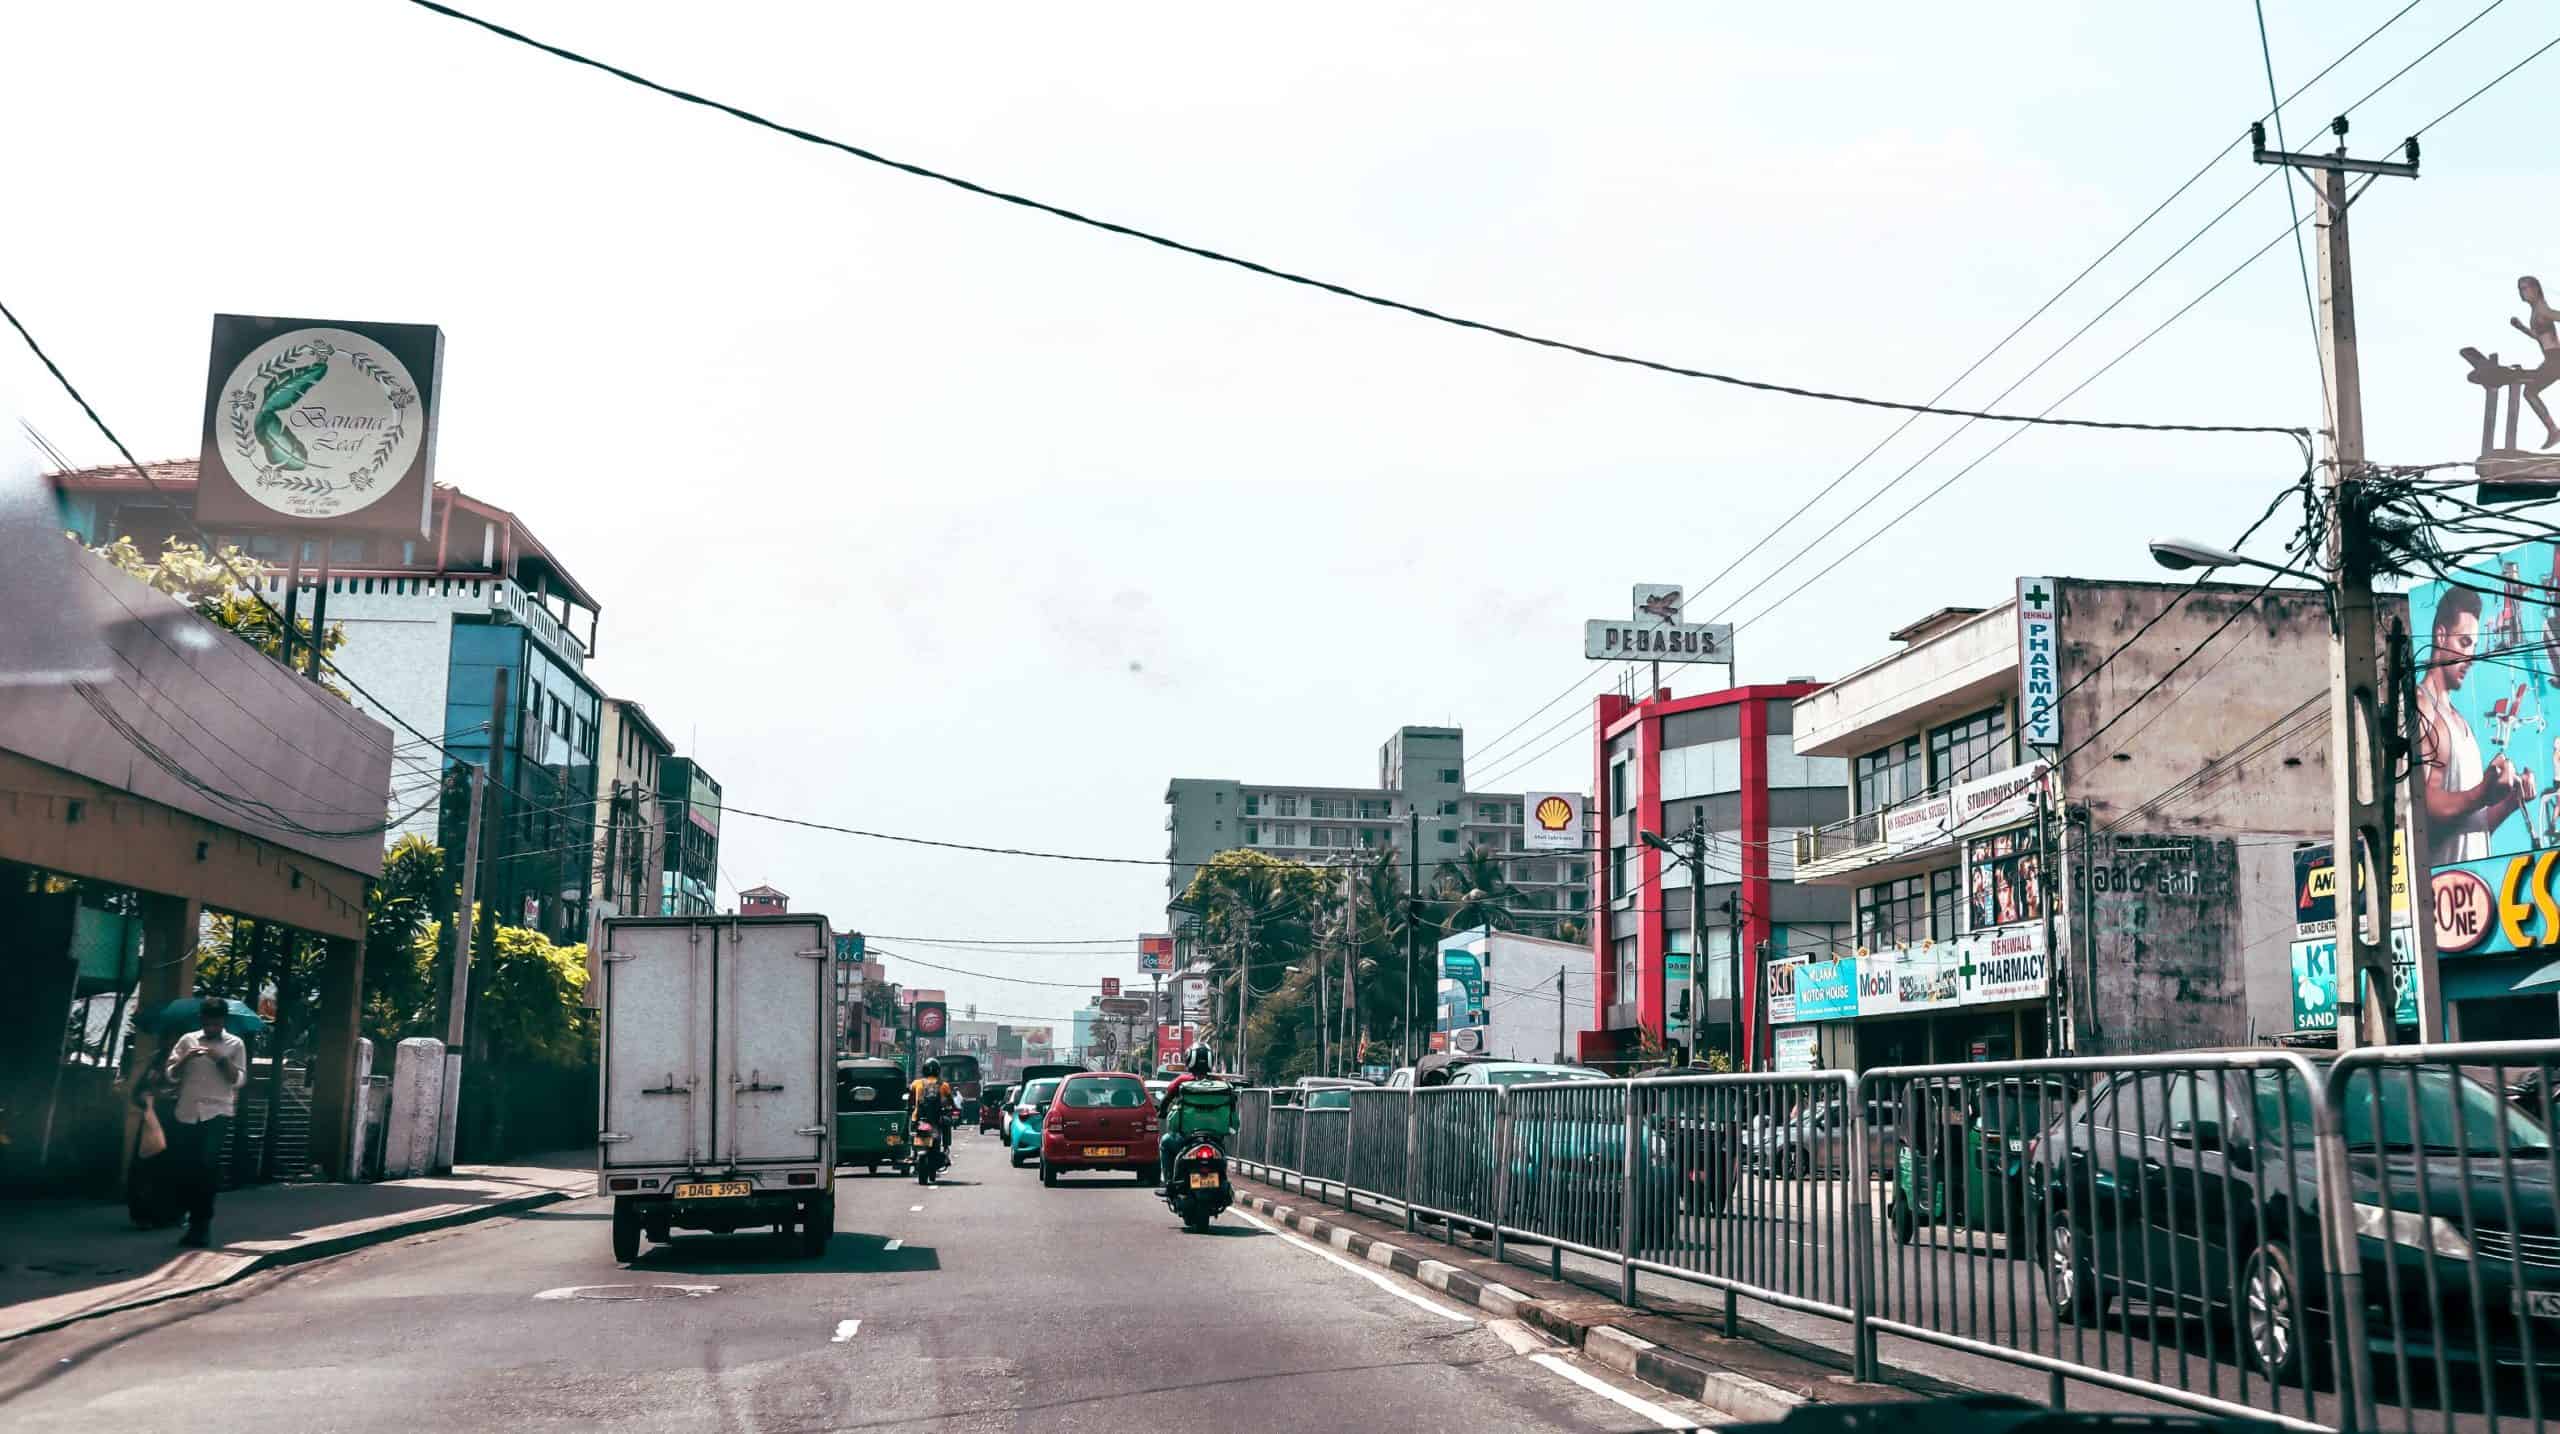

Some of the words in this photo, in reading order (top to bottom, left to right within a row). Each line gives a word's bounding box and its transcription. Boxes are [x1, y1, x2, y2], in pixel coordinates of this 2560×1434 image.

[289, 406, 384, 431] Banana
[312, 431, 369, 451] Leaf
[1606, 628, 1716, 654] PEGASUS
[2029, 624, 2051, 738] PHARMACY
[2316, 921, 2337, 933] CENTR
[1991, 935, 2032, 957] DEHIWALA
[1979, 954, 2045, 986] PHARMACY
[1826, 984, 1849, 1000] HOUSE
[1860, 969, 1892, 998] Mobil
[688, 1184, 713, 1197] DAG
[719, 1182, 748, 1196] 3953
